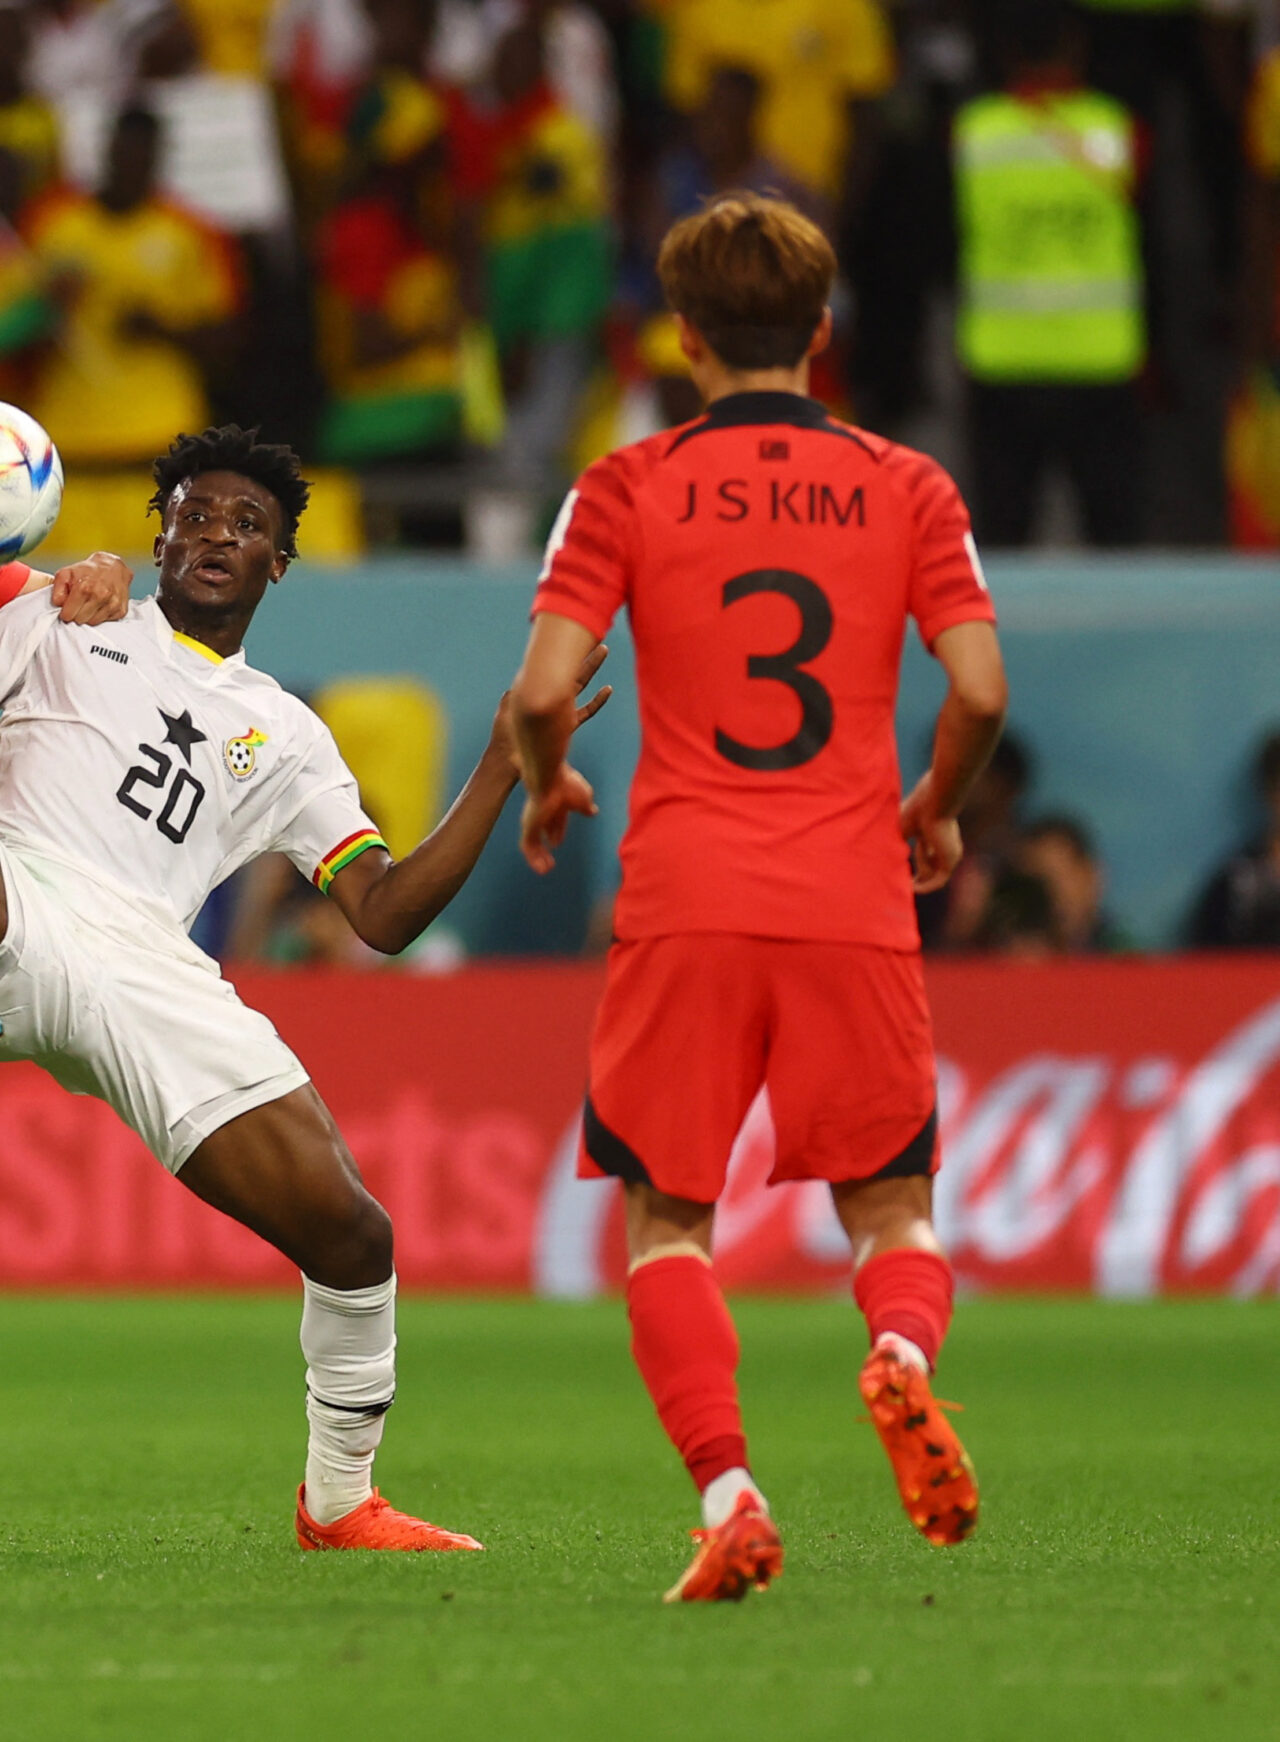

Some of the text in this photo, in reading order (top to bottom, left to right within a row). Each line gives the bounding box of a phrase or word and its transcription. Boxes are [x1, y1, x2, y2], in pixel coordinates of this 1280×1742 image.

[677, 478, 866, 528] J S KIM
[90, 644, 129, 665] PUMA
[713, 567, 834, 771] 3
[116, 743, 206, 844] 20
